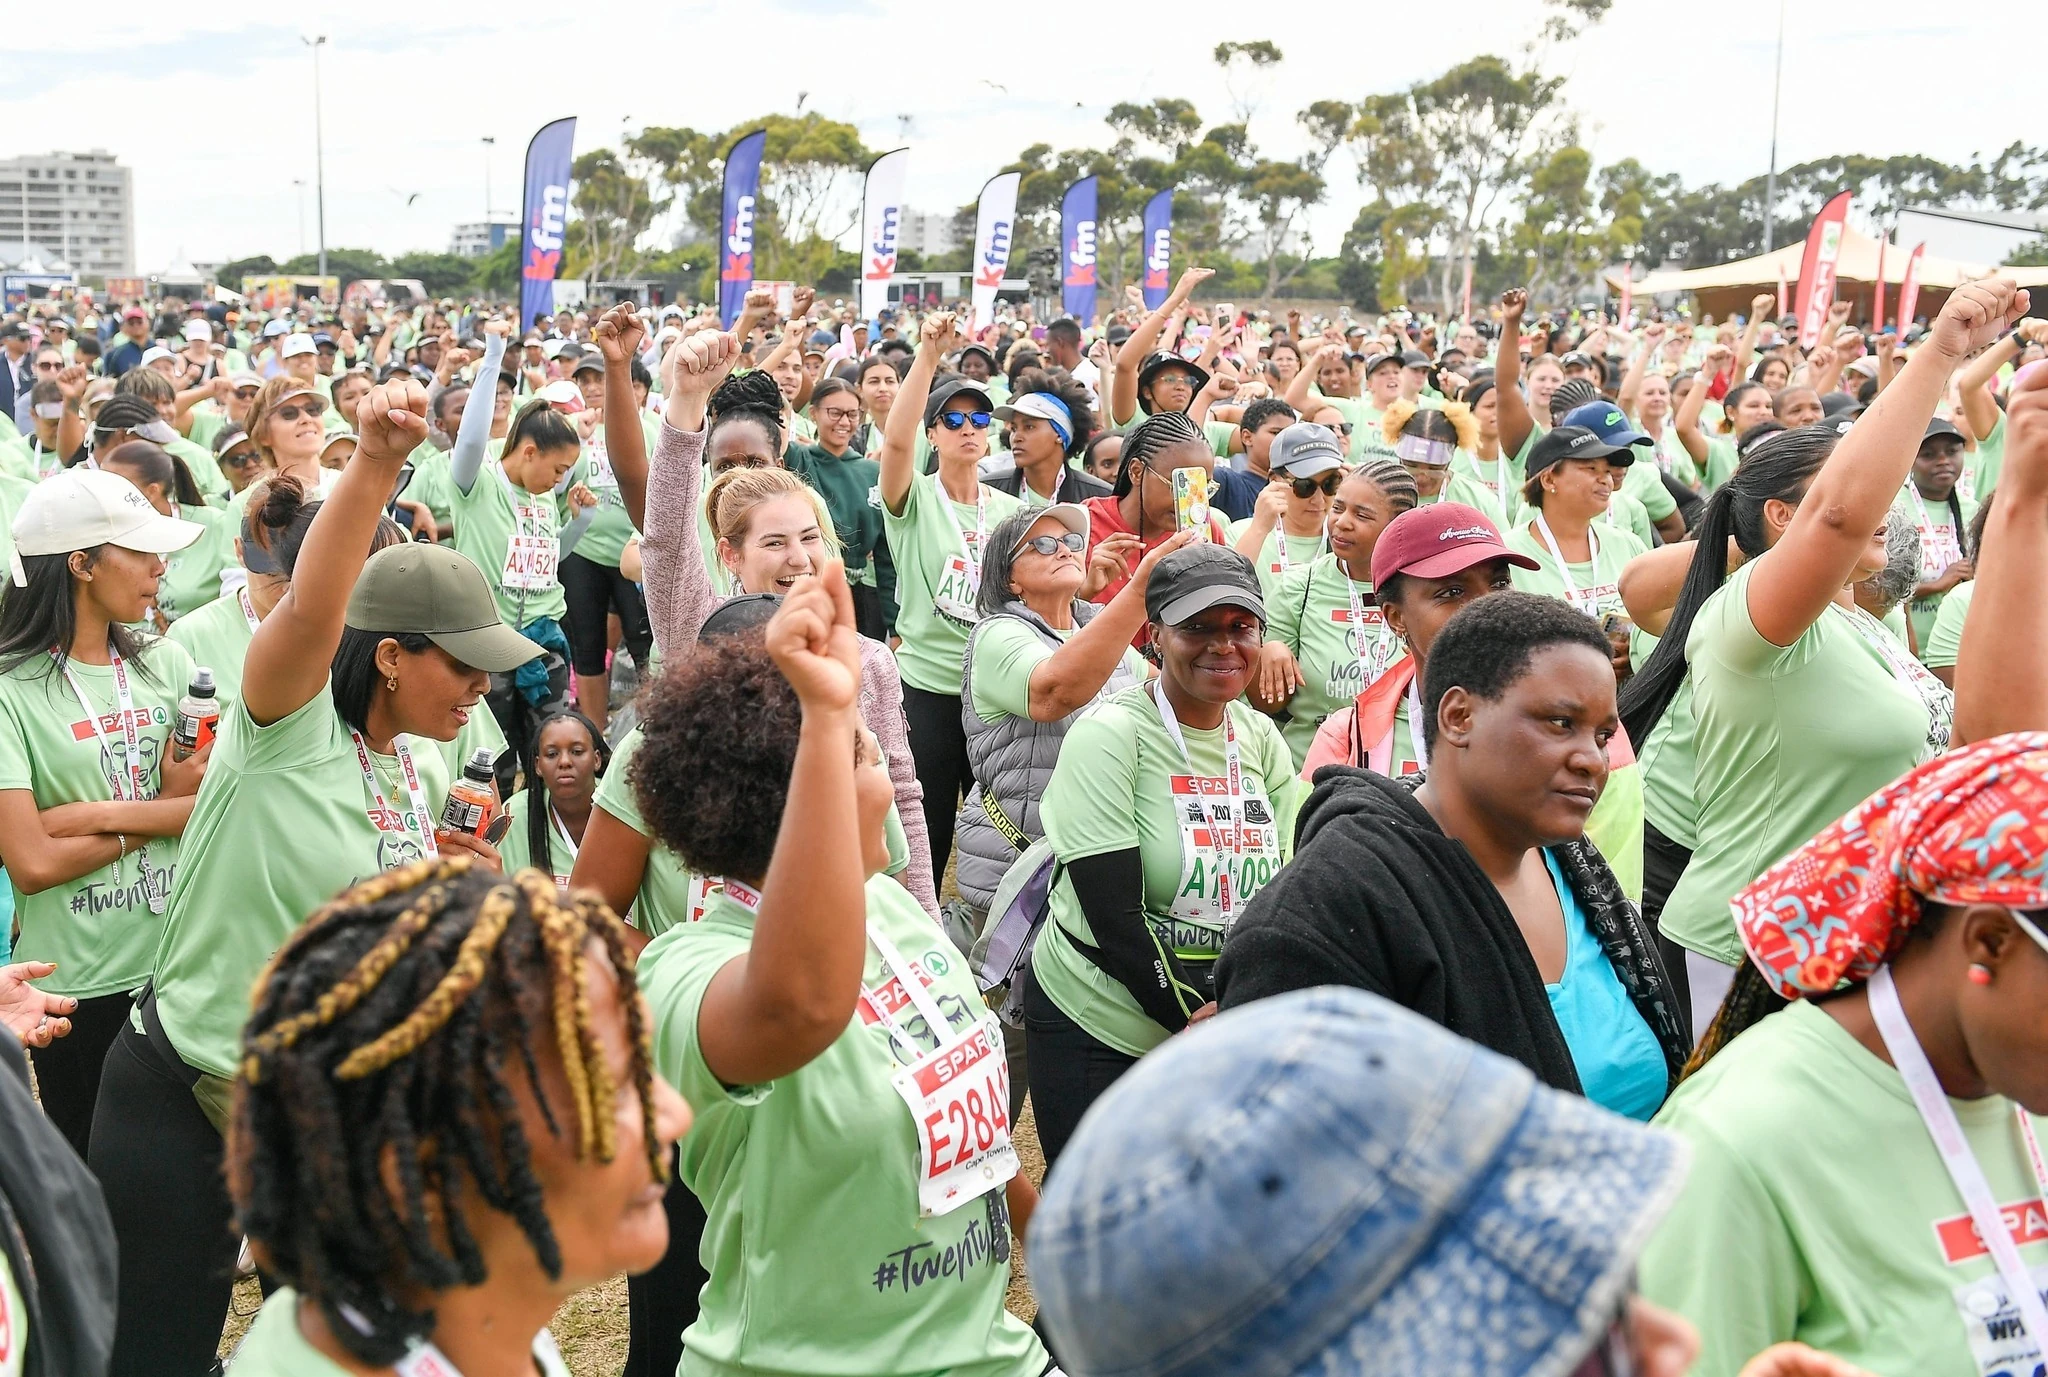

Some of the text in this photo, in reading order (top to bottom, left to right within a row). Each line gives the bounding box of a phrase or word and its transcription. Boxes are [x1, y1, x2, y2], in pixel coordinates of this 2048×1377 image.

[523, 184, 566, 281] kfm
[721, 195, 755, 281] kfm
[866, 206, 898, 280] kfm
[976, 221, 1009, 288] kfm
[1064, 221, 1096, 287] kfm
[1147, 228, 1170, 289] kfm
[506, 551, 557, 576] A521
[125, 717, 136, 744] SPAR
[356, 741, 371, 773] SPAR
[402, 754, 417, 785] SPAR
[1188, 779, 1227, 792] SPA
[1230, 762, 1239, 789] SPAR
[983, 793, 1022, 845] PARADISE
[1246, 802, 1267, 815] ASA
[419, 814, 433, 844] SPAR
[1220, 881, 1231, 911] SPAR
[934, 1033, 991, 1083] SPAR
[965, 1155, 985, 1171] Cape
[986, 1145, 1007, 1159] Town
[872, 1218, 993, 1294] #Twenty
